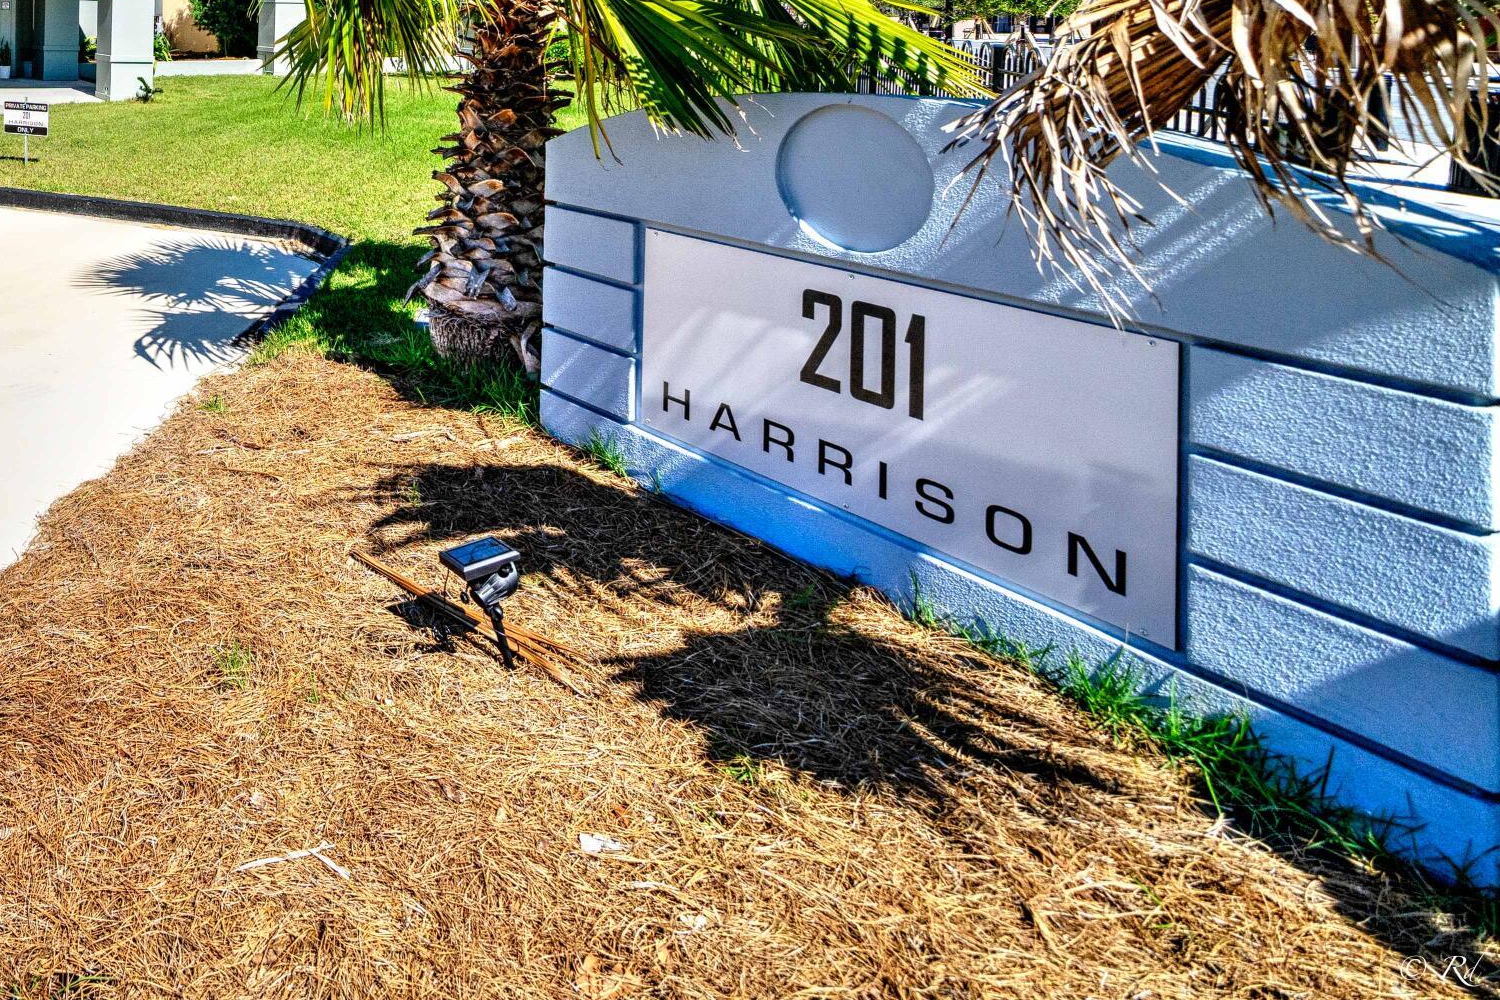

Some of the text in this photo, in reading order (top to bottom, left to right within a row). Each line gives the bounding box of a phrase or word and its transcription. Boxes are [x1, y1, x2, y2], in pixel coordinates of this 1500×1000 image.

[22, 111, 31, 120] 201
[800, 288, 925, 421] 201
[662, 380, 1127, 597] HARRISON
